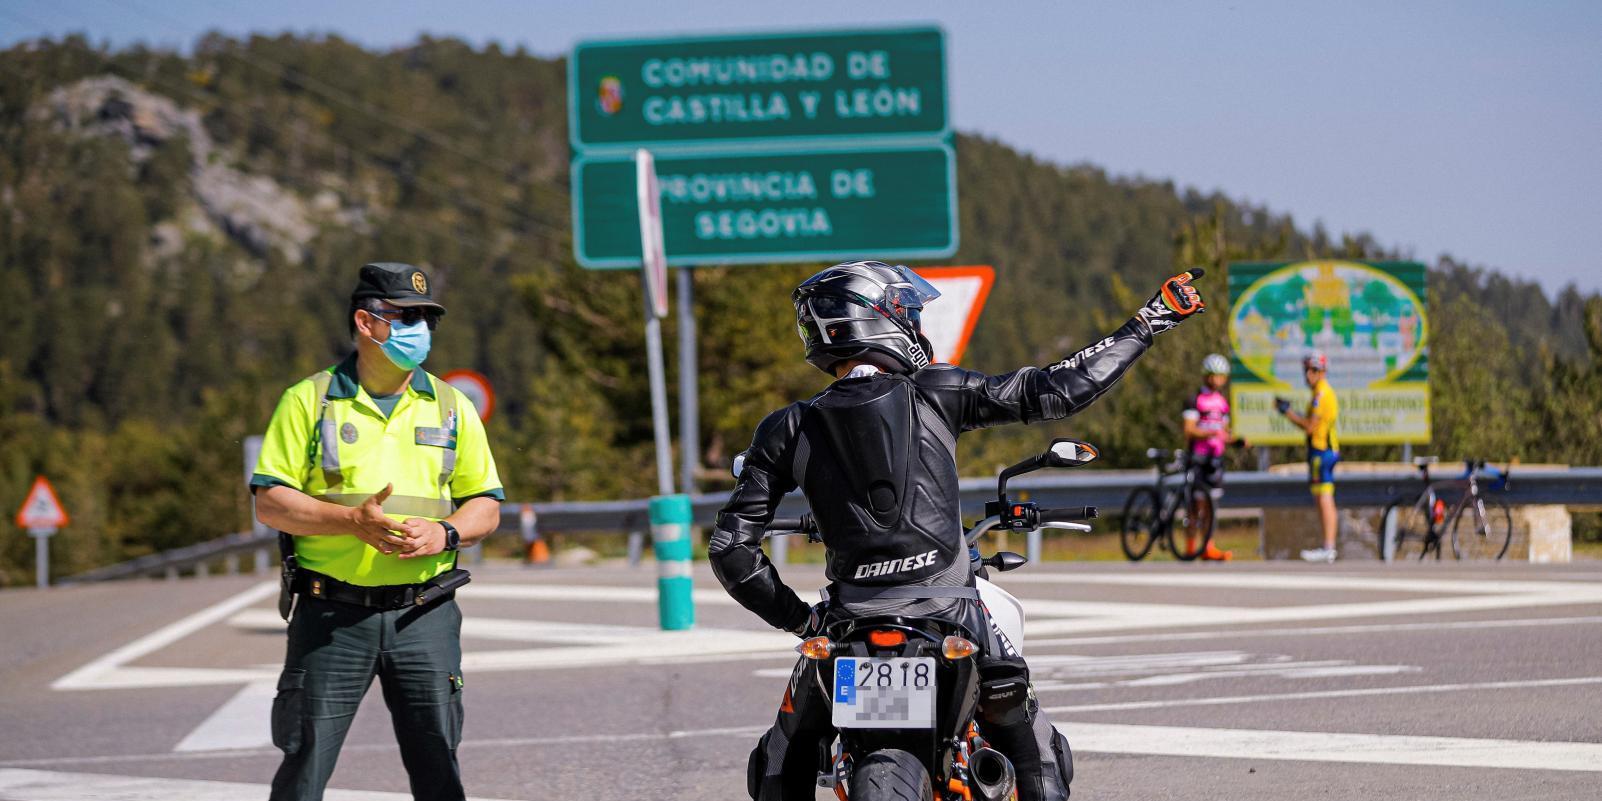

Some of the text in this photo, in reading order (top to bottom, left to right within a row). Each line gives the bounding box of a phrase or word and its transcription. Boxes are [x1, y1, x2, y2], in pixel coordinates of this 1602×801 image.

[642, 50, 889, 87] COMUNIDAD DE
[643, 86, 921, 124] CASTILLA Y LEÓN
[831, 168, 874, 197] DE
[695, 208, 832, 239] SEGOVIA
[858, 661, 929, 687] 2818
[840, 685, 849, 696] E
